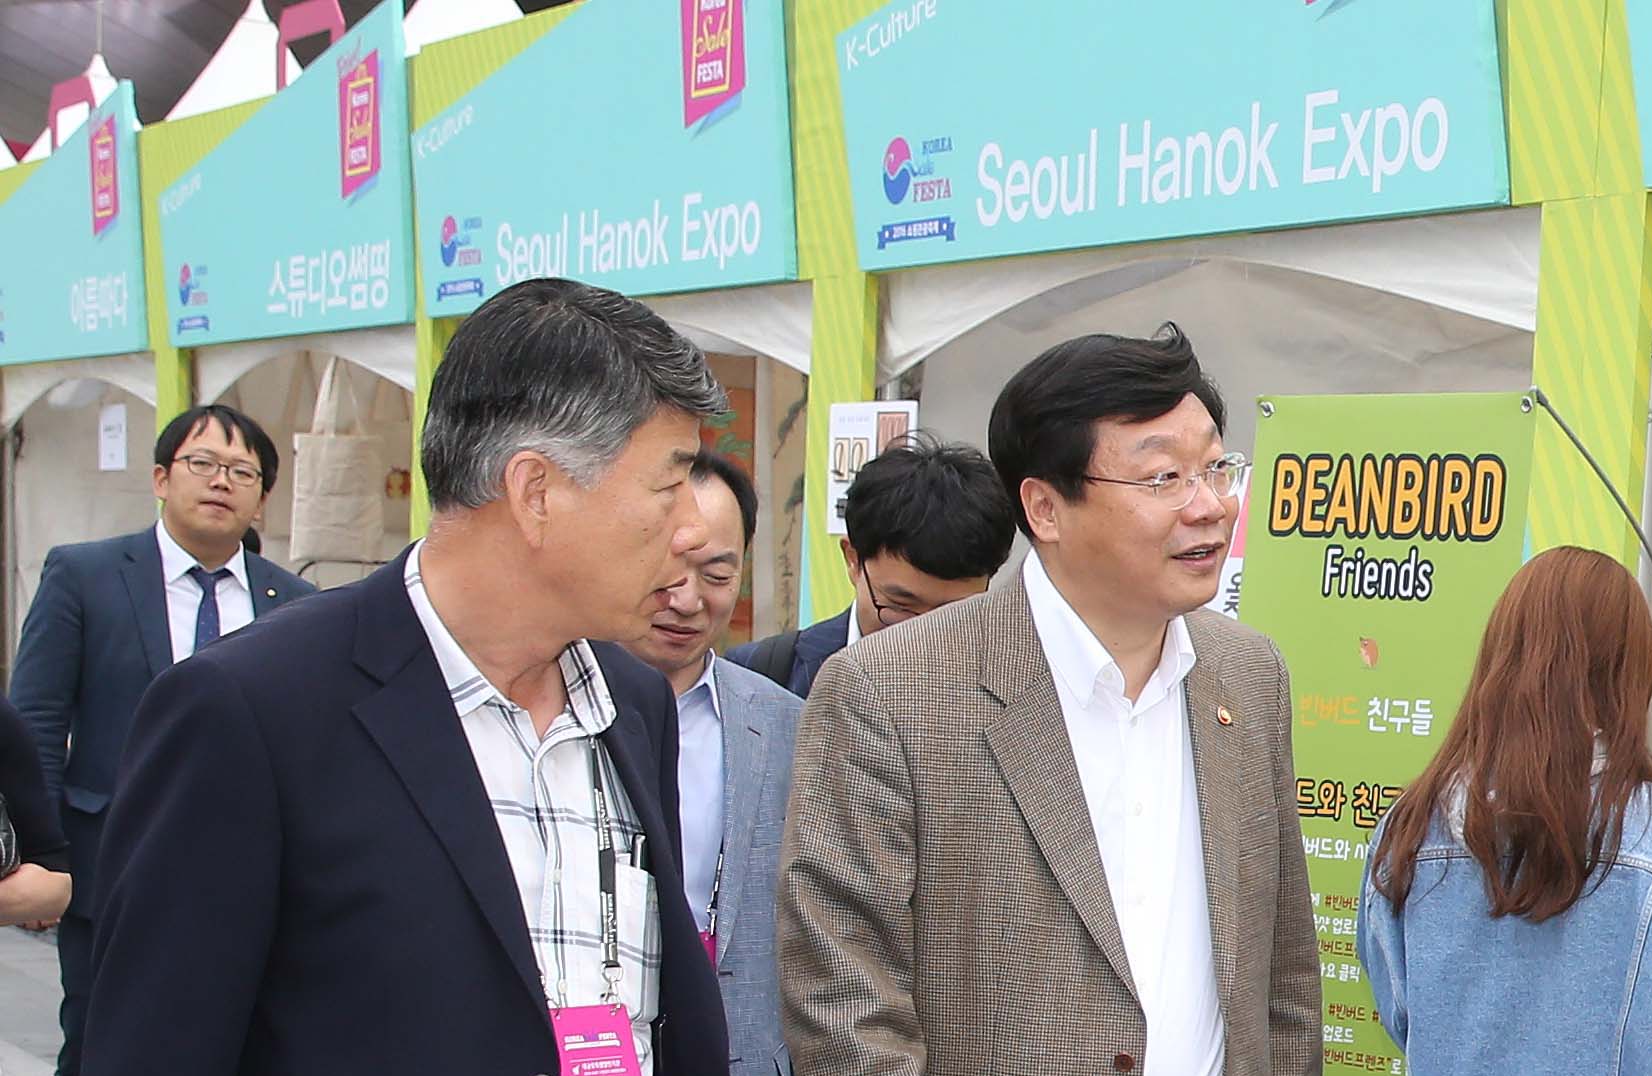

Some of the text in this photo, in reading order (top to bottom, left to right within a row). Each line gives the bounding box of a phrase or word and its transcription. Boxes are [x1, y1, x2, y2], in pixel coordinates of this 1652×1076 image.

[845, 0, 937, 71] K-Culture
[696, 59, 725, 84] FESTA
[976, 90, 1449, 228] Seoul Hanok Expo
[496, 191, 761, 286] Seoul Hanok Expo
[266, 239, 391, 319] 스튜디오썸띵
[1268, 453, 1507, 541] BEANBIRD
[1322, 544, 1434, 601] Friends
[1367, 695, 1434, 736] 친구들
[1302, 834, 1351, 861] 버드와
[1322, 1024, 1355, 1044] 업로드
